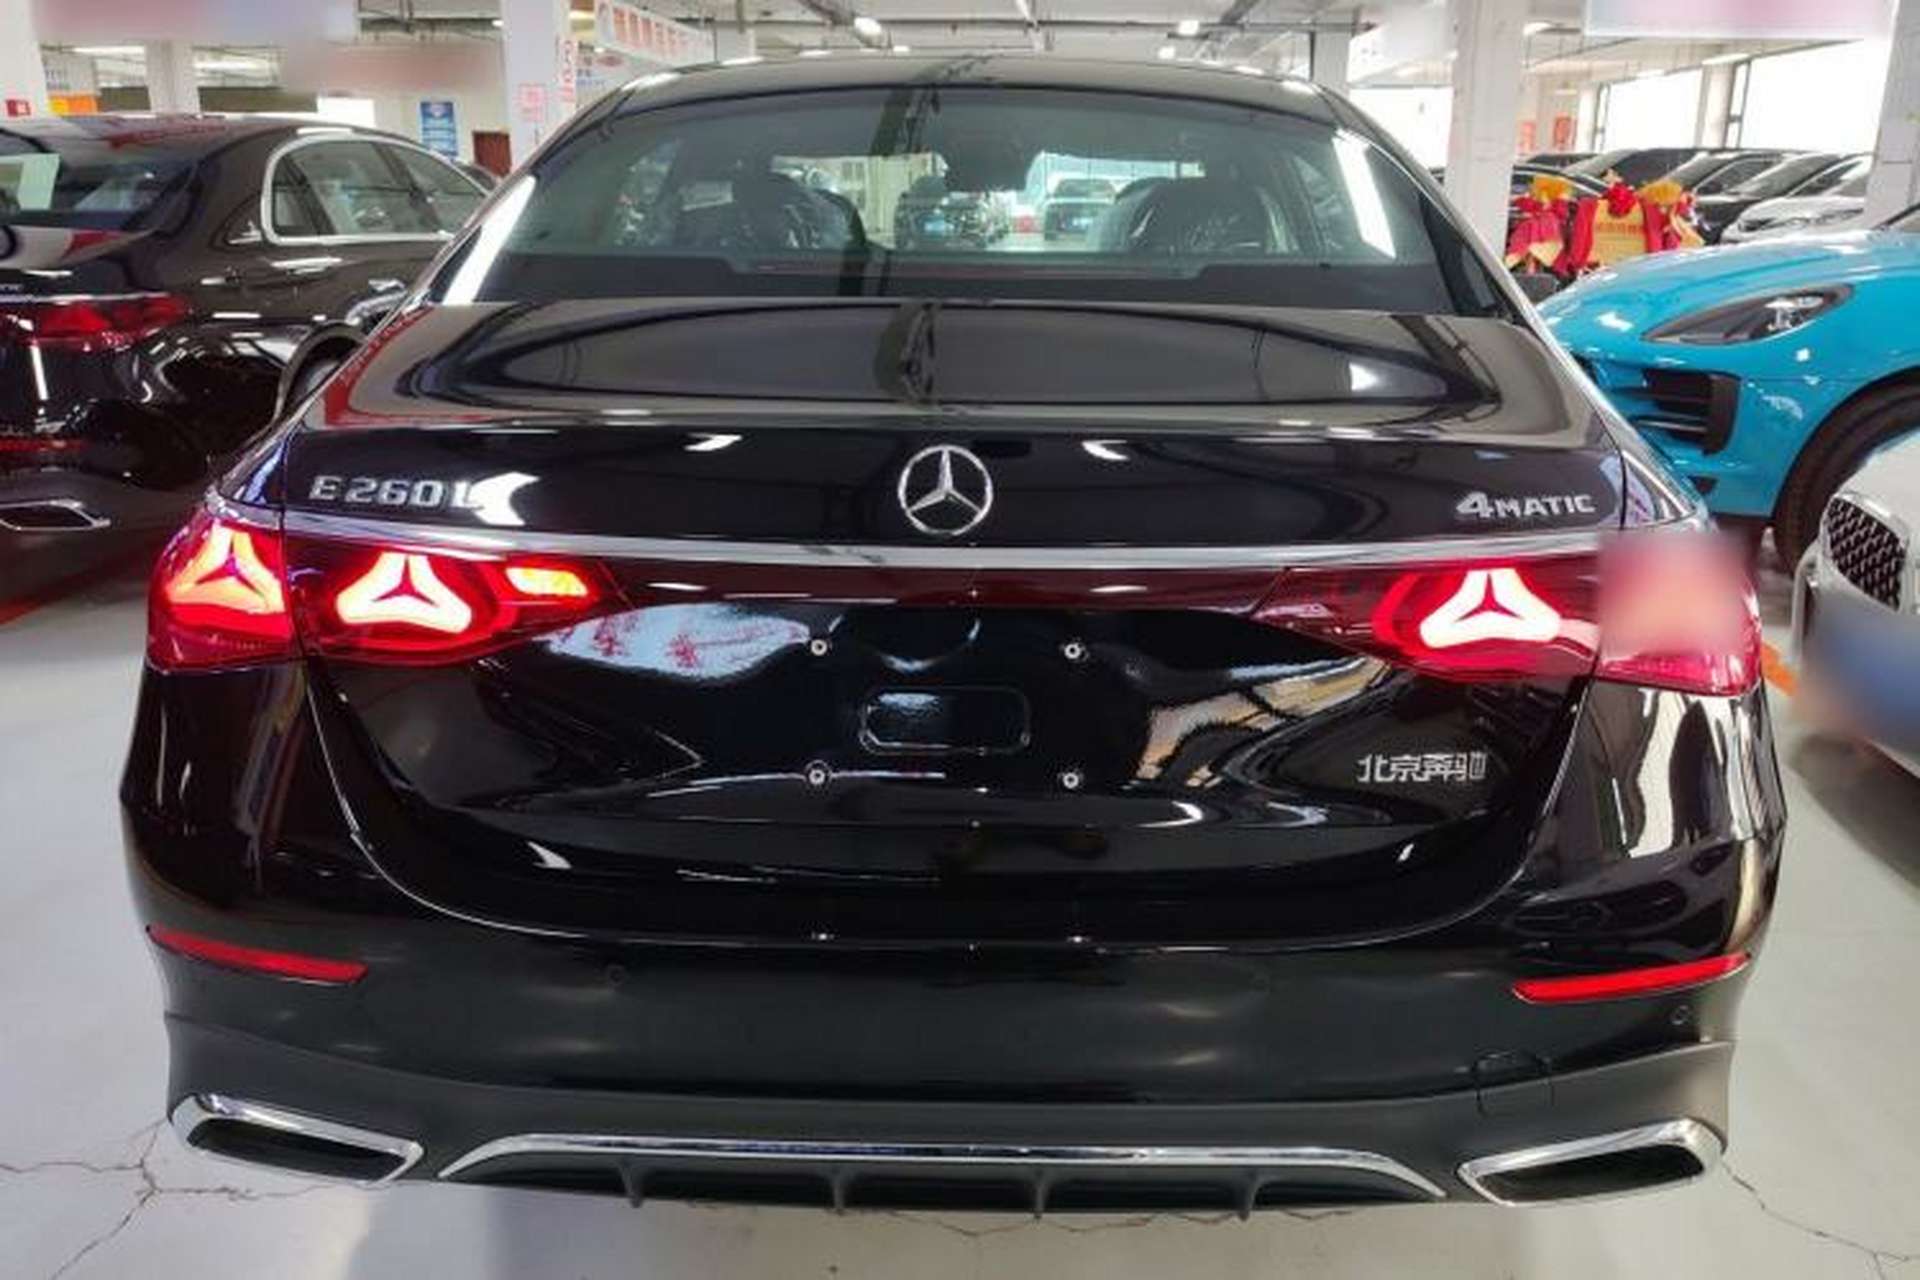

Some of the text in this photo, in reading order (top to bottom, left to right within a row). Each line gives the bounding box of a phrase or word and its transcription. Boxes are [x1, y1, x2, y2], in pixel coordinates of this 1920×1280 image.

[308, 475, 342, 500] E
[345, 477, 445, 507] 260
[1456, 491, 1596, 518] 4MATIC
[1357, 751, 1487, 782] 北京奔驰
